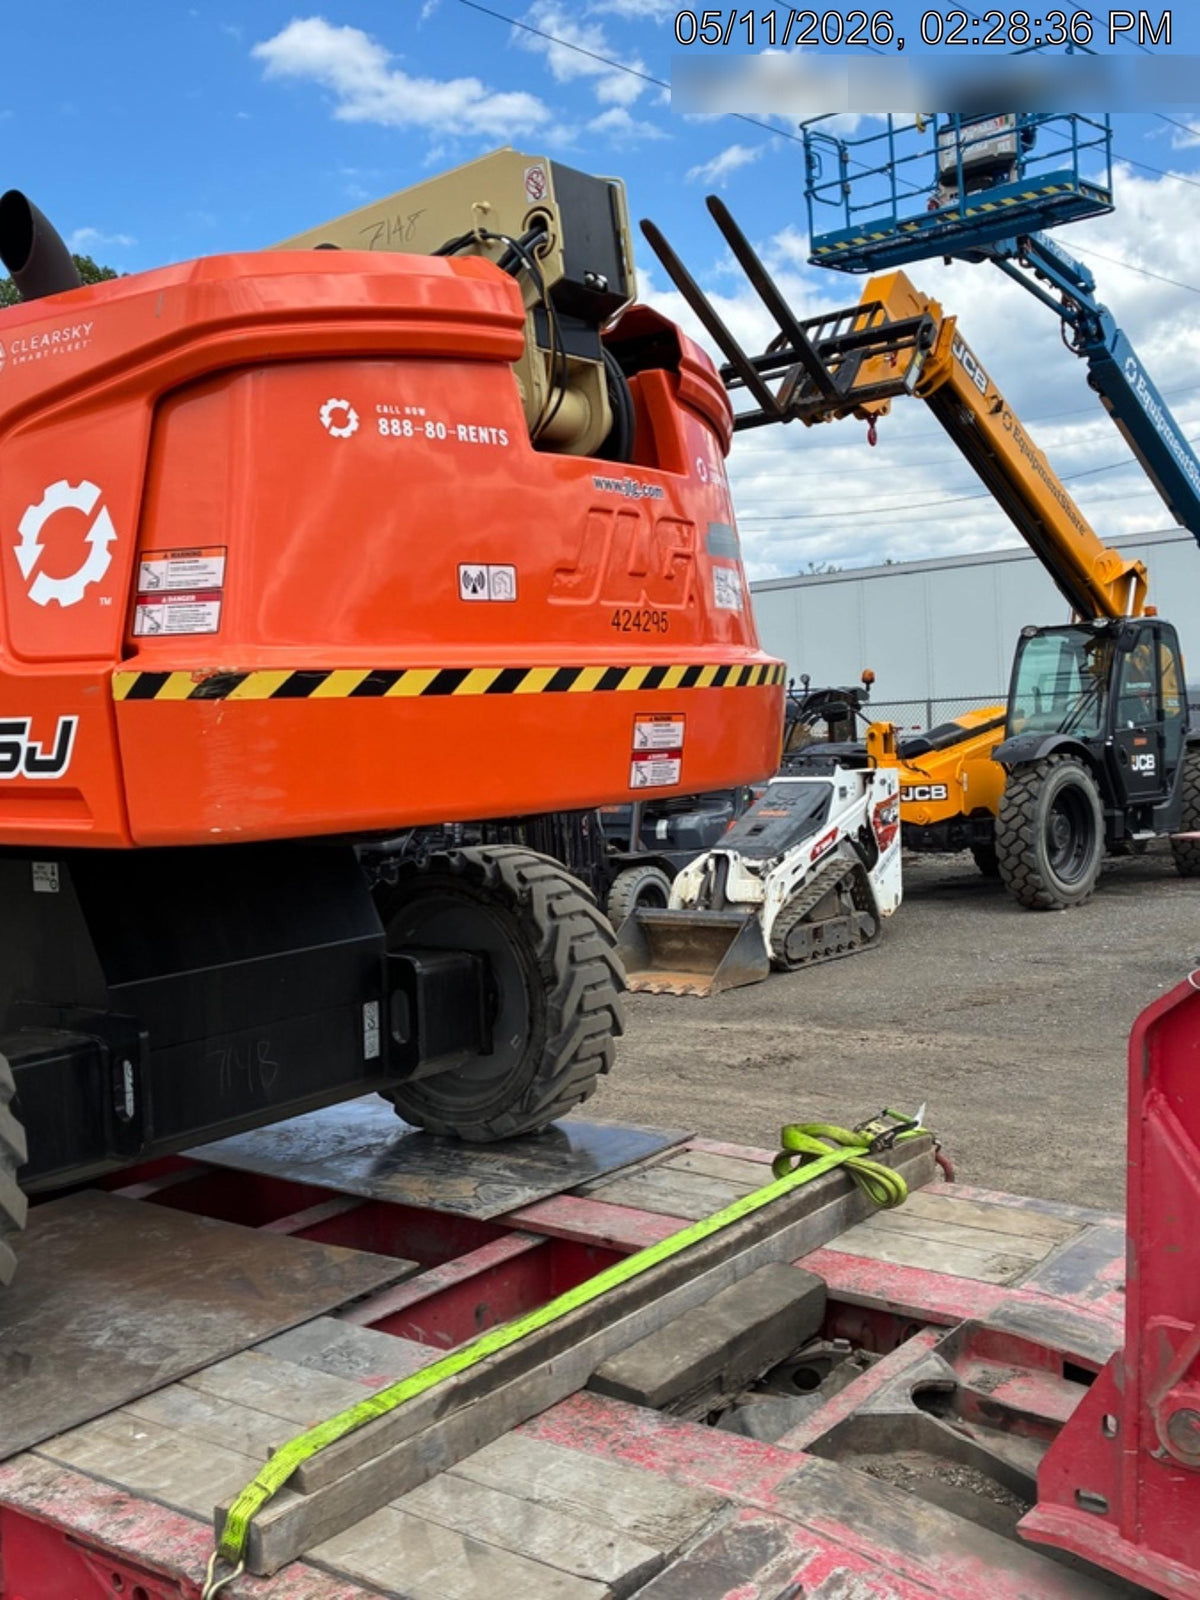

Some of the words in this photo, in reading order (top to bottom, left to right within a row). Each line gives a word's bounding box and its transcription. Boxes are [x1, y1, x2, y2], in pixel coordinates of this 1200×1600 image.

[360, 209, 427, 250] 7148
[11, 321, 94, 355] CLEARSKY
[952, 334, 989, 396] JCB
[376, 404, 401, 415] CALL
[378, 417, 509, 446] 888-80-RENTS
[591, 475, 664, 500] www.jlg.com
[611, 609, 669, 633] 424295
[1131, 754, 1155, 771] JCB
[900, 784, 947, 801] JCB
